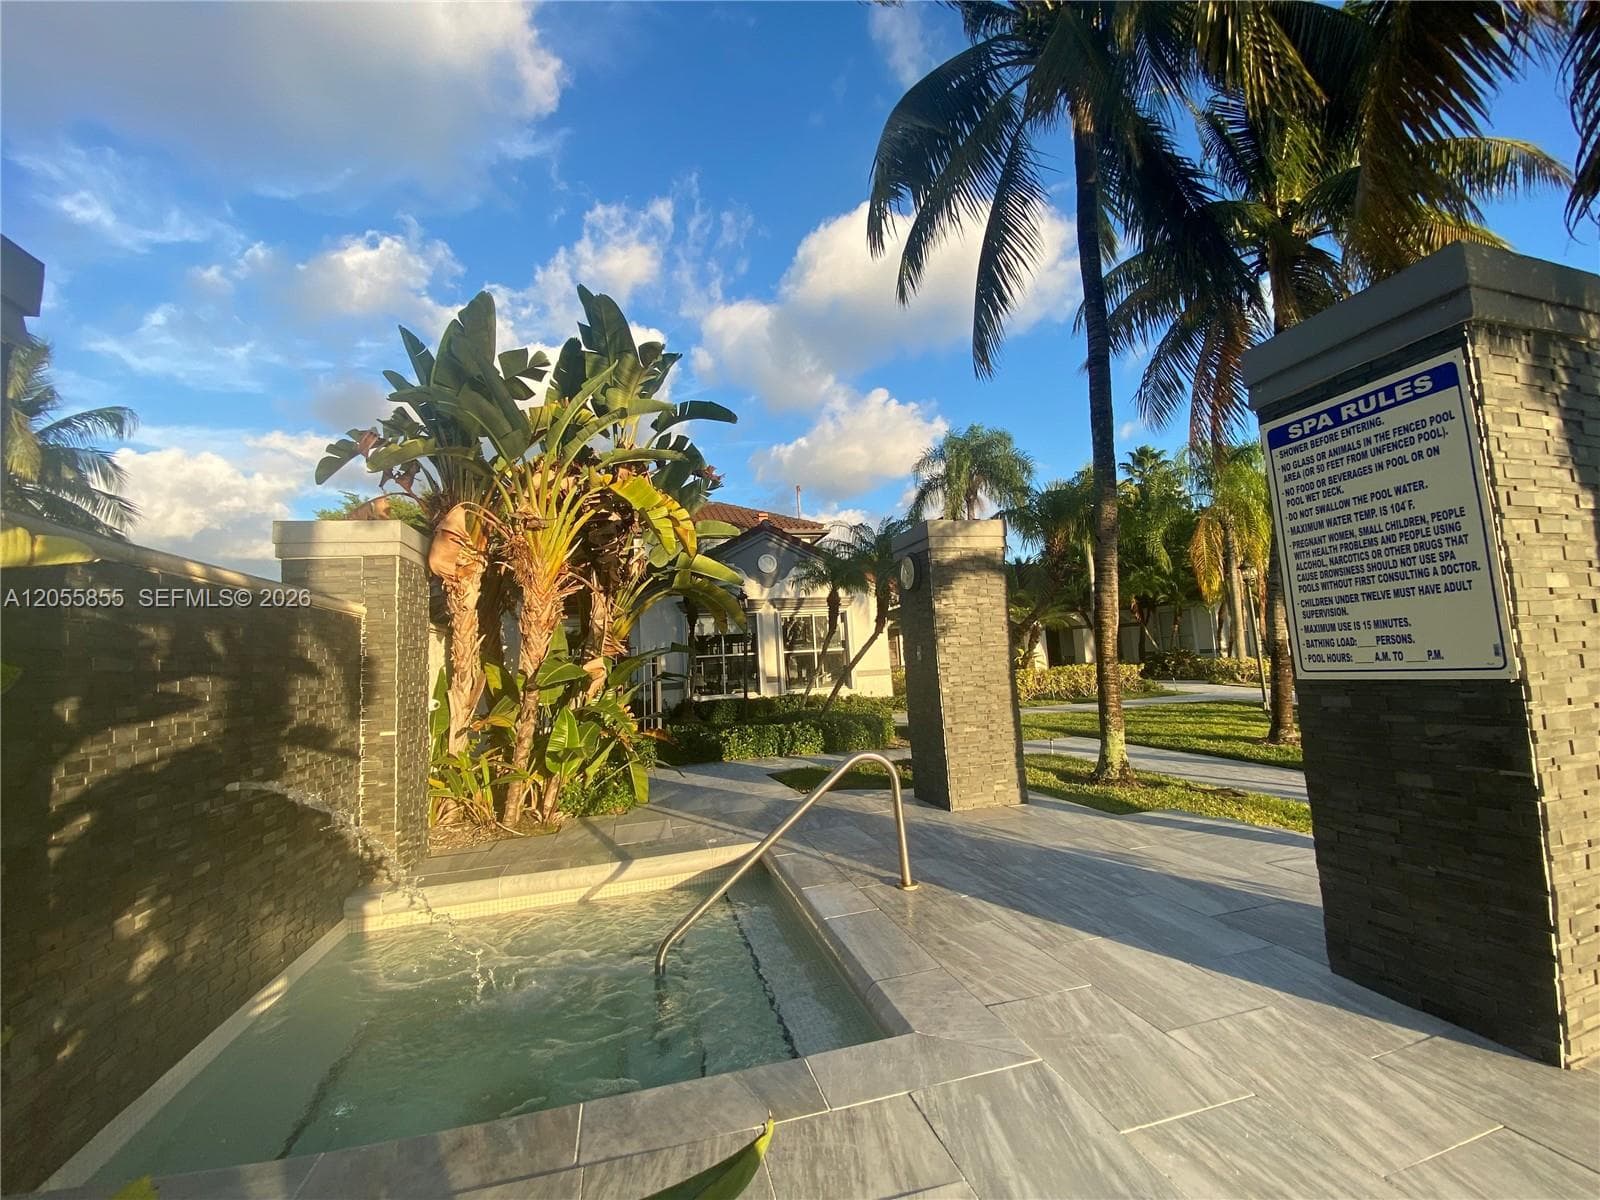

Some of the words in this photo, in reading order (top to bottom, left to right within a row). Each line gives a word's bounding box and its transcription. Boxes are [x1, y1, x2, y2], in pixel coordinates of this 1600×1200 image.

[1288, 414, 1333, 438] SPA
[1341, 376, 1432, 421] RULES
[1280, 443, 1308, 458] SHOWER
[1310, 432, 1339, 449] BEFORE
[1341, 417, 1384, 438] ENTERING.
[1281, 463, 1291, 472] NO
[1293, 456, 1314, 469] GLASS
[1316, 452, 1326, 461] OR
[1329, 440, 1361, 458] ANIMALS
[1363, 437, 1372, 447] IN
[1374, 431, 1391, 443] THE
[1393, 419, 1426, 437] FENCED
[1429, 410, 1455, 426] POOL
[1284, 472, 1301, 483] AREA
[1303, 467, 1314, 479] (OR
[1317, 464, 1325, 473] 50
[1327, 458, 1344, 470] FEET
[1347, 450, 1368, 464] FROM
[1370, 436, 1415, 457] UNFENCED
[1418, 426, 1448, 443] POOL).
[1285, 488, 1294, 496] NO
[1296, 482, 1314, 493] FOOD
[1316, 479, 1326, 488] OR
[1328, 465, 1373, 485] BEVERAGES
[1375, 462, 1383, 472] IN
[1386, 455, 1409, 469] POOL
[1411, 450, 1424, 461] OR
[1426, 446, 1440, 457] ON
[1287, 496, 1304, 507] POOL
[1305, 492, 1320, 502] WET
[1322, 485, 1344, 498] DECK.
[1289, 512, 1297, 521] DO
[1300, 508, 1313, 518] NOT
[1315, 497, 1351, 515] SWALLOW
[1352, 494, 1368, 505] THE
[1370, 489, 1392, 501] POOL
[1394, 480, 1428, 496] WATER.
[1290, 521, 1324, 535] MAXIMUM
[1326, 514, 1352, 527] WATER
[1354, 508, 1377, 521] TEMP.
[1380, 506, 1388, 516] IS
[1292, 535, 1326, 549] PREGNANT
[1359, 524, 1383, 536] SMALL
[1385, 514, 1429, 531] CHILDREN,
[1431, 507, 1465, 522] PEOPLE
[1294, 550, 1310, 560] WITH
[1312, 545, 1337, 557] HEALTH
[1340, 537, 1378, 552] PROBLEMS
[1381, 534, 1396, 545] AND
[1400, 527, 1431, 541] PEOPLE
[1433, 522, 1461, 535] USING
[1329, 551, 1369, 566] NARCOTICS
[1372, 549, 1382, 559] OR
[1384, 544, 1411, 557] OTHER
[1413, 539, 1443, 552] DRUGS
[1445, 534, 1468, 547] THAT
[1297, 572, 1318, 582] CAUSE
[1320, 564, 1364, 579] DROWSINESS
[1367, 560, 1397, 572] SHOULD
[1400, 556, 1416, 567] NOT
[1419, 553, 1437, 564] USE
[1439, 550, 1456, 561] SPA
[1299, 583, 1320, 593] POOLS
[1321, 578, 1352, 590] WITHOUT
[1355, 575, 1375, 586] FIRST
[1378, 568, 1430, 583] CONSULTING
[1433, 566, 1439, 576] A
[1441, 561, 1480, 575] DOCTOR.
[1301, 596, 1333, 608] CHILDREN
[1335, 594, 1359, 604] UNDER
[1361, 590, 1391, 601] TWELVE
[1393, 587, 1415, 598] MUST
[1418, 584, 1441, 595] HAVE
[1444, 580, 1472, 592] ADULT
[1302, 607, 1349, 619] SUPERVISION.
[1304, 623, 1336, 633] MAXIMUM
[1338, 622, 1352, 631] USE
[1354, 621, 1360, 630] IS
[1363, 621, 1371, 629] 15
[1374, 618, 1411, 629] MINUTES.
[1306, 639, 1335, 648] BATHING
[1337, 637, 1357, 647] LOAD:
[1308, 654, 1325, 663] POOL
[1327, 653, 1352, 662] HOURS:
[1393, 651, 1403, 661] TO
